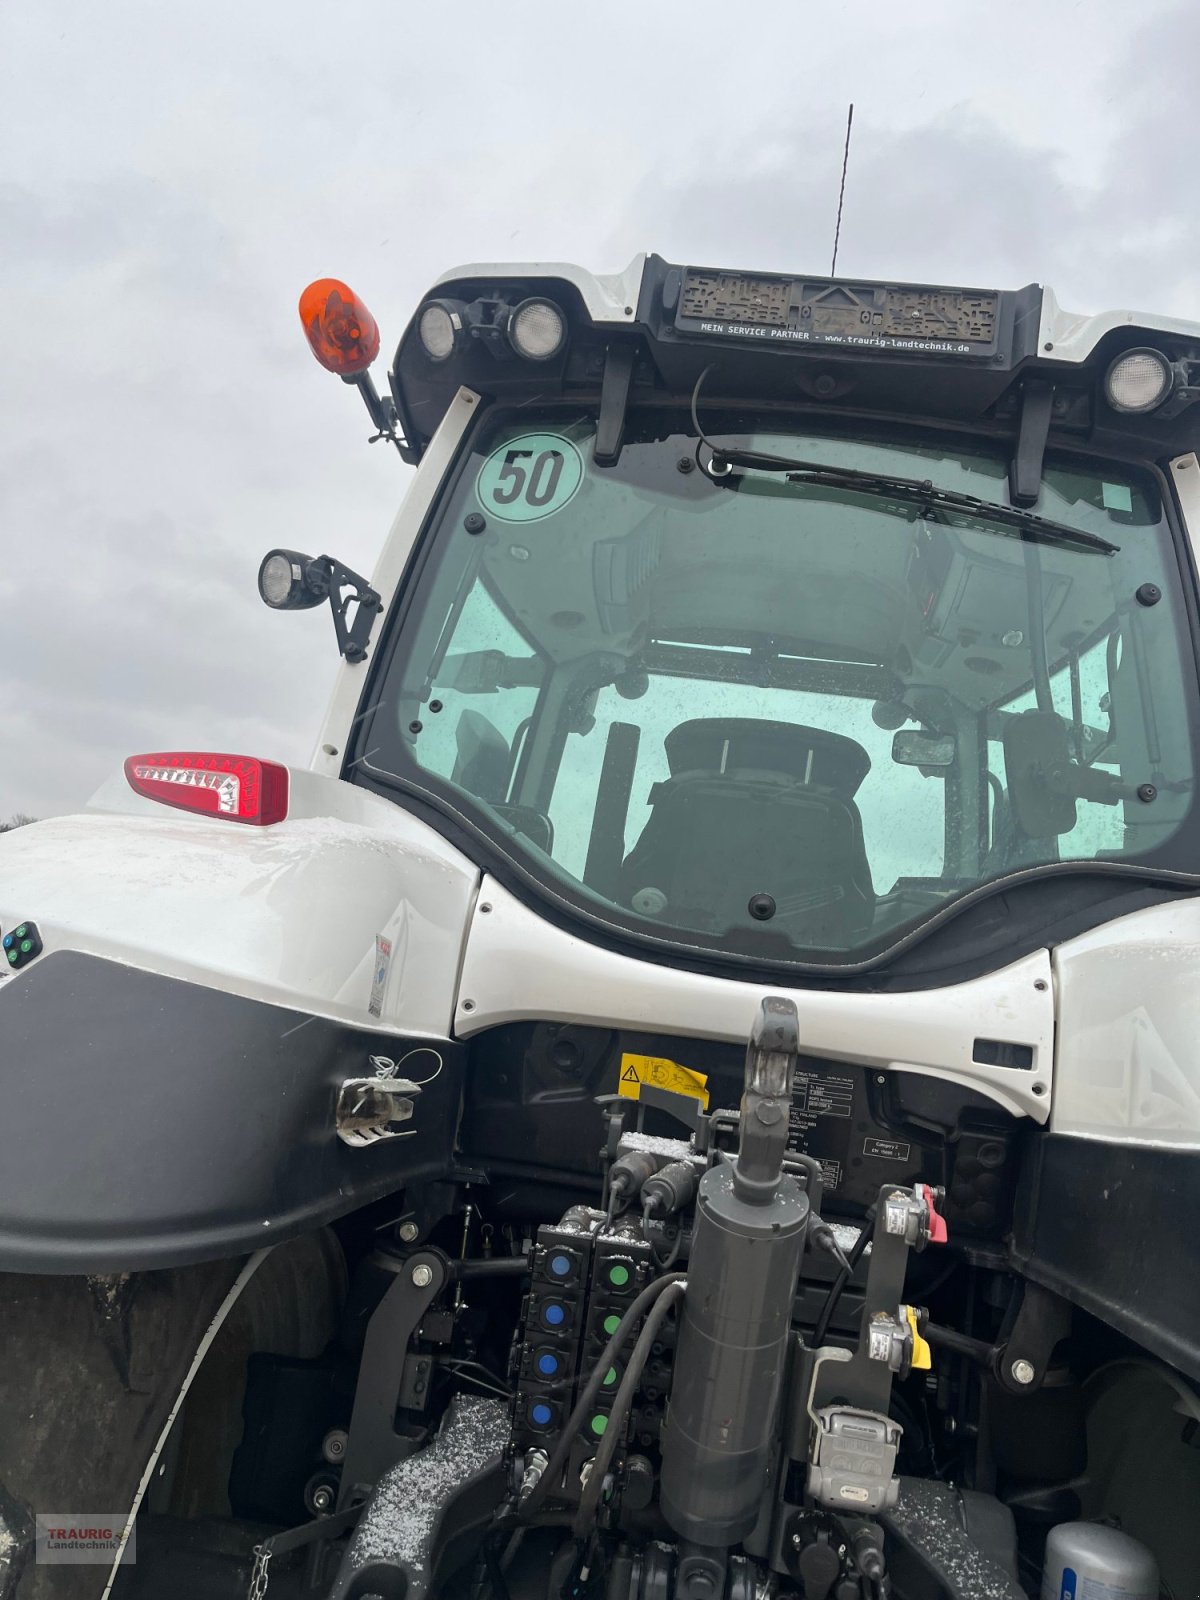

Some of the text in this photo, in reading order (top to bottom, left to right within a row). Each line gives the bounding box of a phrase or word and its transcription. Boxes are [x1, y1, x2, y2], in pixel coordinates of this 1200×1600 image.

[701, 323, 723, 332] MEIN
[728, 325, 766, 336] SERVICE
[771, 329, 810, 340] PARTNER
[825, 335, 970, 352] www.traurig-landtechnik.de
[493, 450, 564, 507] 50
